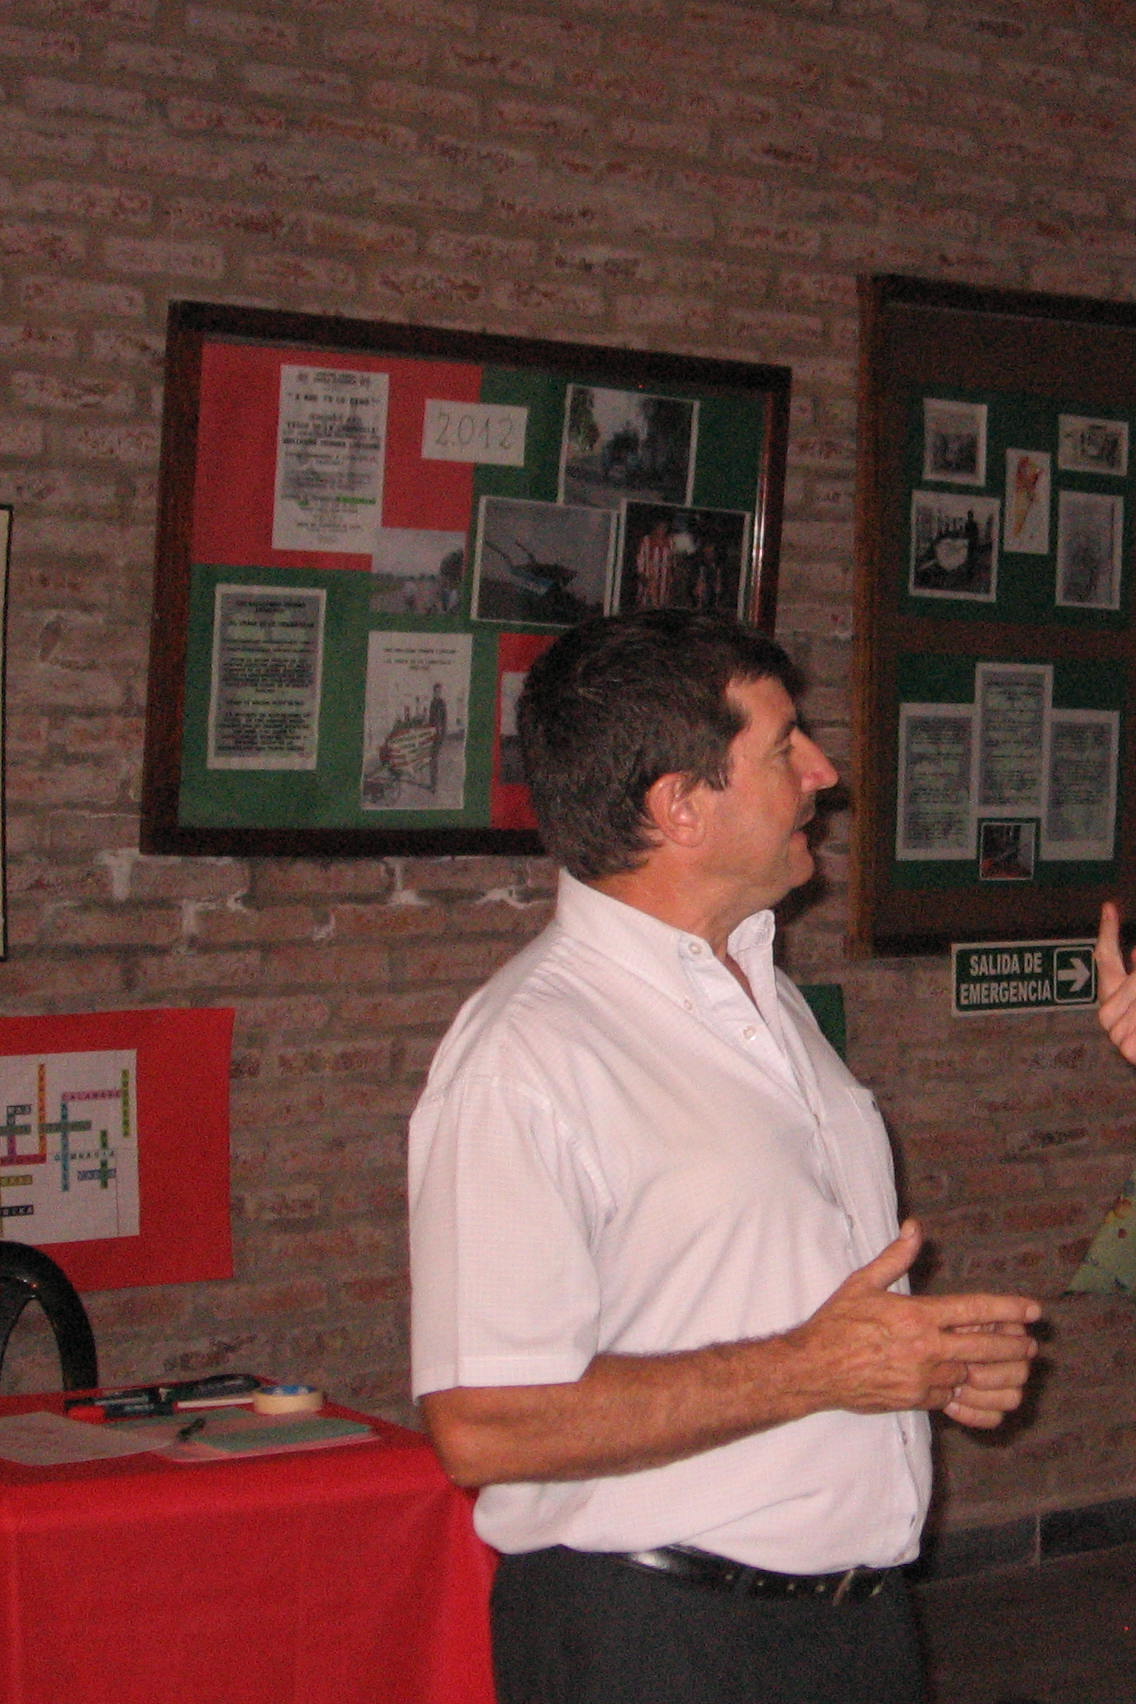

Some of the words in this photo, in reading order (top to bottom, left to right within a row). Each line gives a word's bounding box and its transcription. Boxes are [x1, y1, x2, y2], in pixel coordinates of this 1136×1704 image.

[969, 953, 1020, 976] SALIDA
[1023, 952, 1042, 973] DE
[961, 980, 1051, 1005] EMERGENCIA
